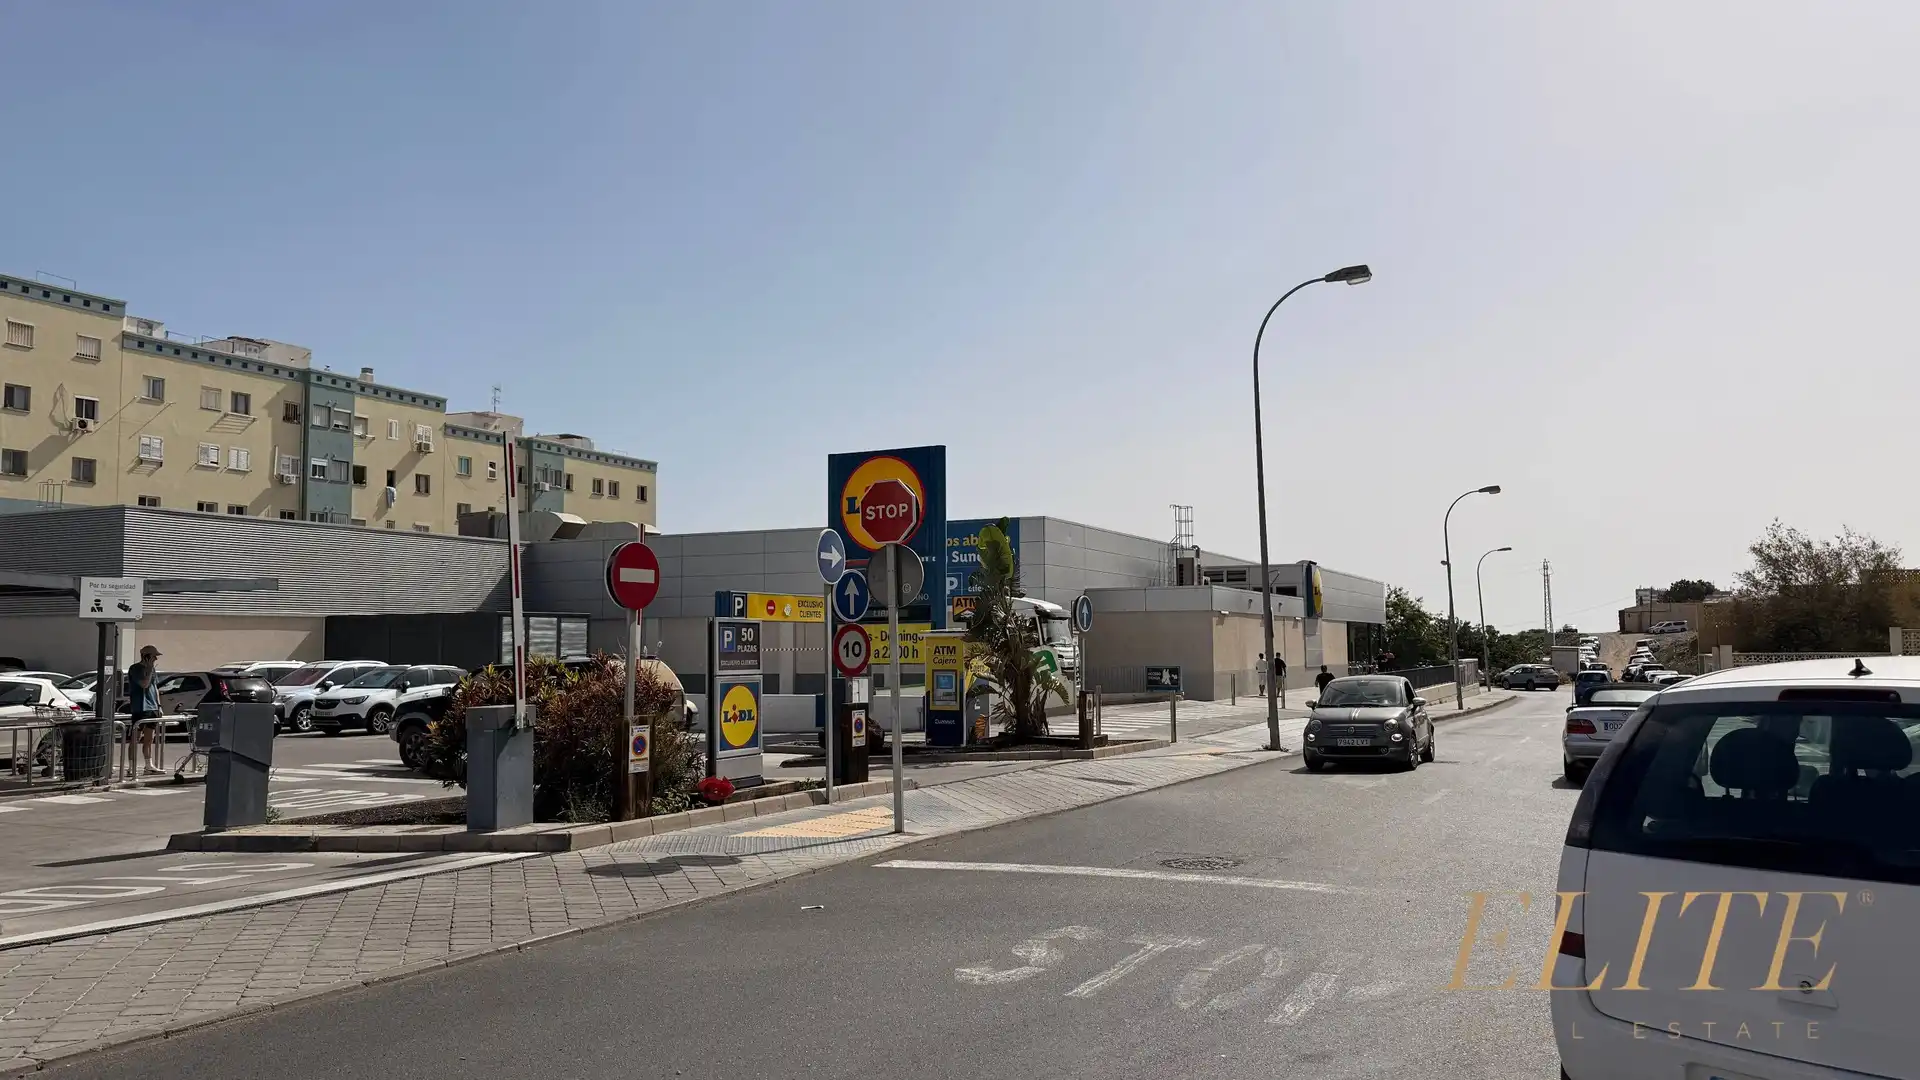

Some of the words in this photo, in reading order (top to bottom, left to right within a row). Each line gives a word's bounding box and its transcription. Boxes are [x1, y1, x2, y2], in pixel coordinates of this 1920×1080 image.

[865, 503, 909, 521] STOP
[89, 581, 100, 589] Por
[108, 582, 136, 590] seguridad
[734, 597, 744, 617] P
[797, 600, 824, 609] EXCLUSIVO
[799, 610, 822, 619] CLIENTES
[723, 630, 733, 649] P
[741, 627, 754, 642] 50
[737, 644, 758, 653] PLAZAS
[843, 640, 862, 658] 10
[912, 645, 919, 659] h
[933, 645, 957, 655] ATM
[933, 656, 957, 666] Cajero
